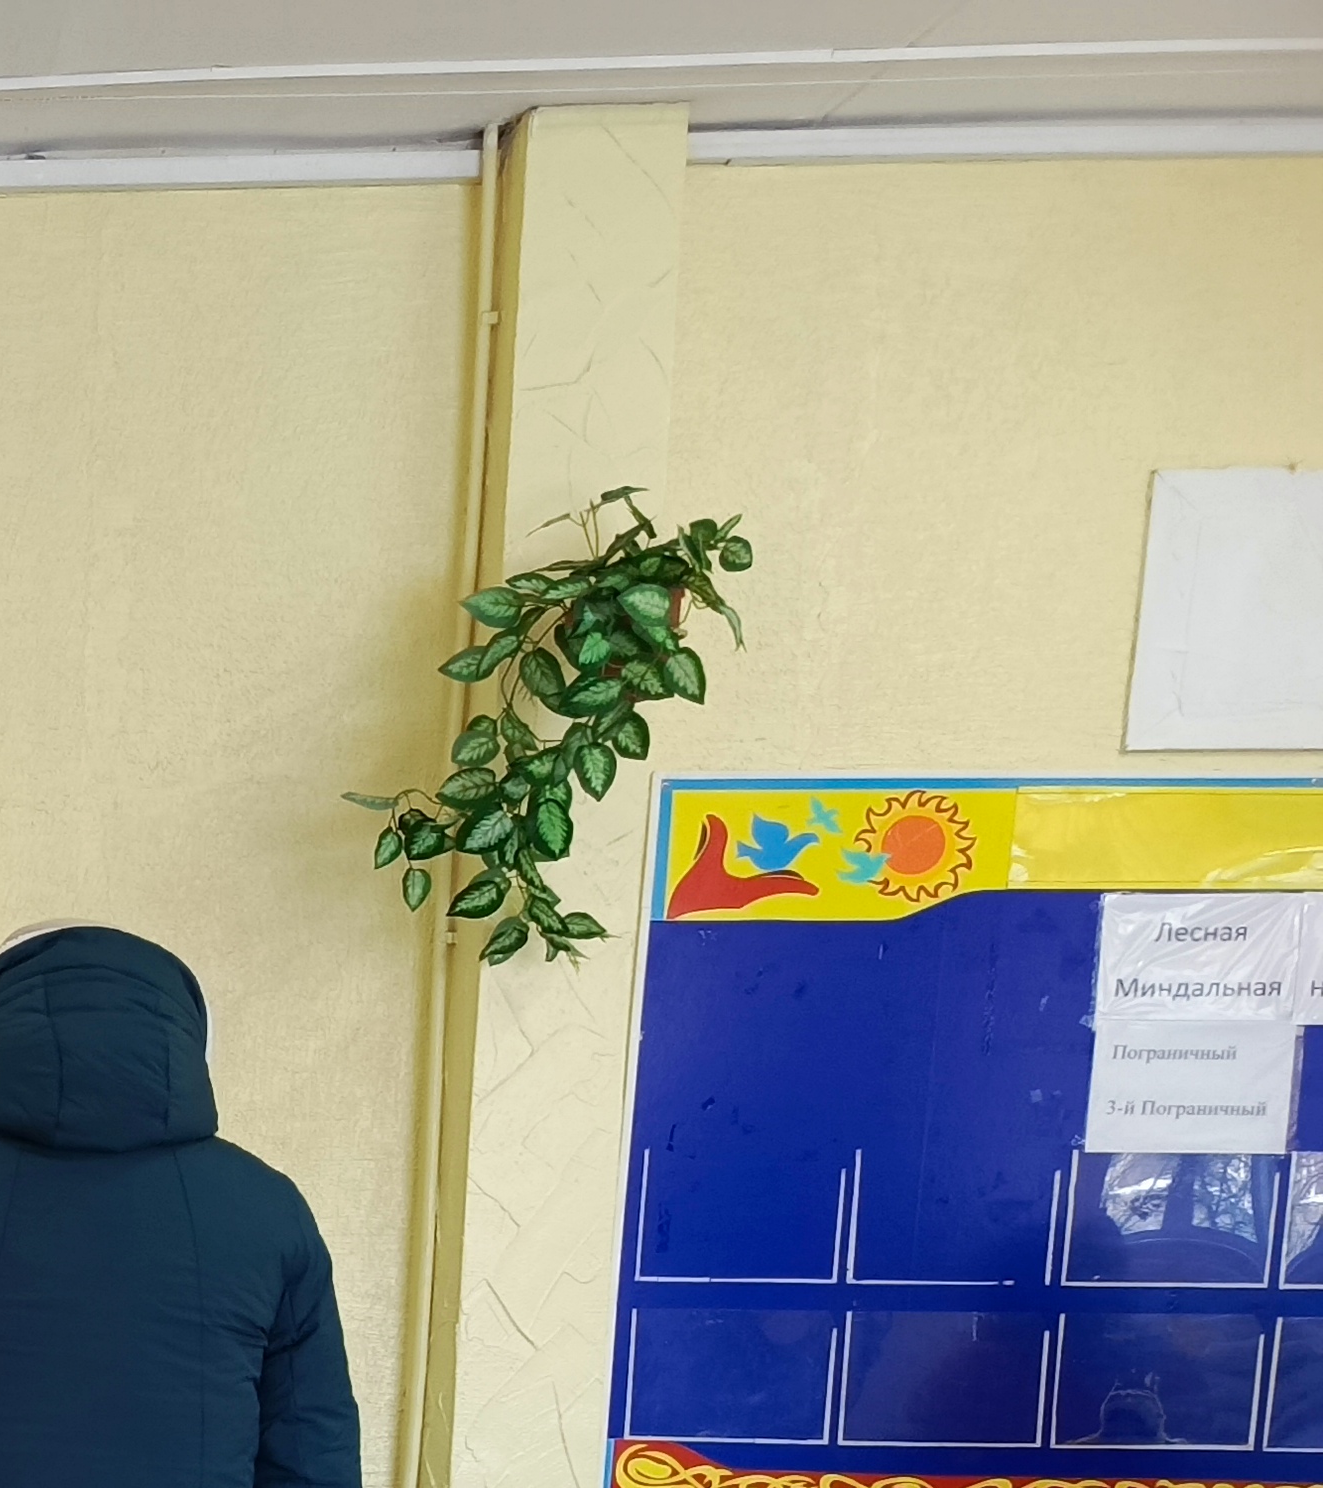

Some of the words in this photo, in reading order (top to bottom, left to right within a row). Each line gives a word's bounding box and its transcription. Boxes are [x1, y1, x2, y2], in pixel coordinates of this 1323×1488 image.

[1155, 922, 1248, 942] Лесная
[1114, 977, 1282, 1001] Миндальная
[1112, 1045, 1237, 1063] Пограничный
[1106, 1100, 1135, 1116] 3-й
[1141, 1100, 1267, 1119] Пограничный
